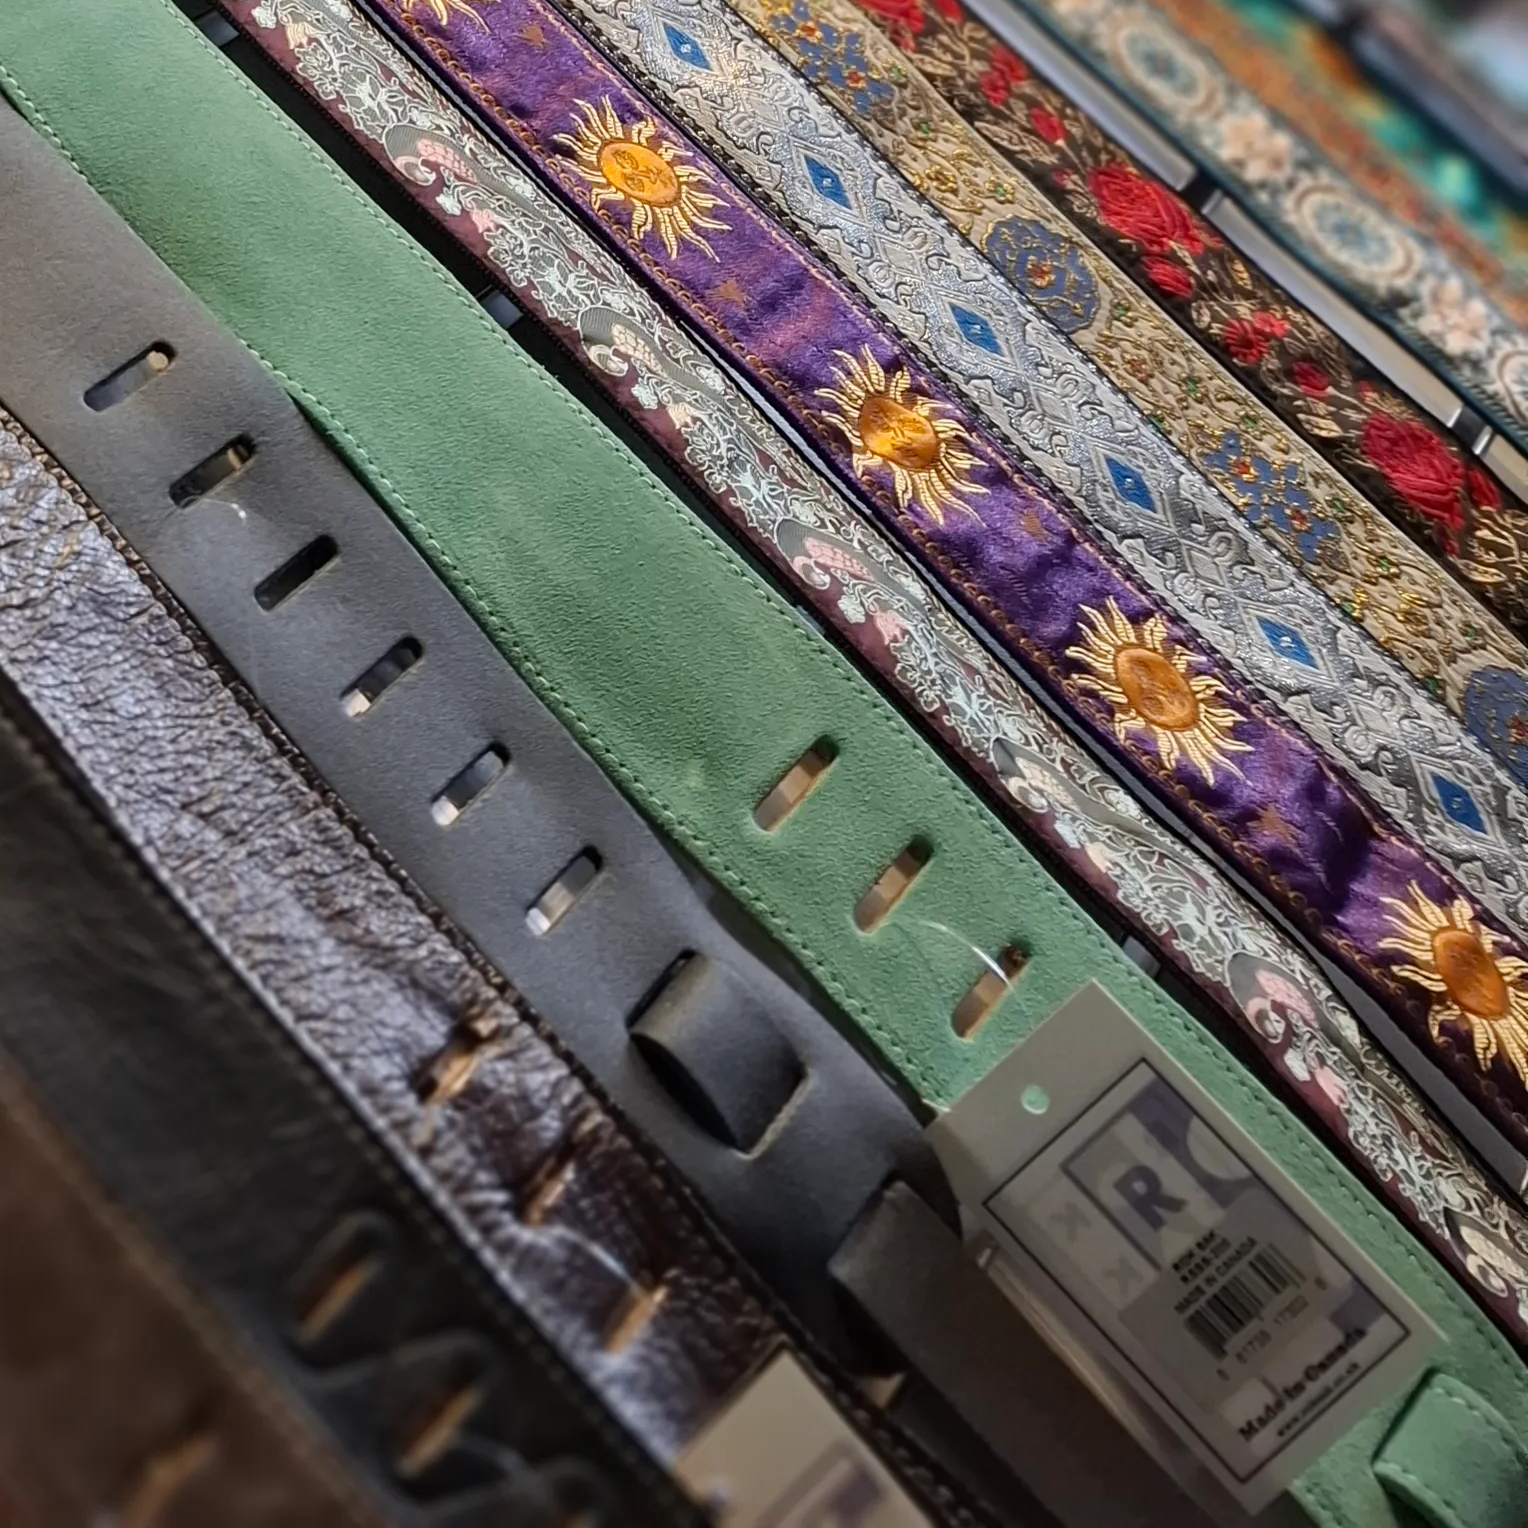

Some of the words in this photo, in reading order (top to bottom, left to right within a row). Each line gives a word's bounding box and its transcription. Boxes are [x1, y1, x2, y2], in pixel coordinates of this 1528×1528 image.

[1112, 1161, 1189, 1235] R
[1172, 1283, 1206, 1316] MADE
[1202, 1271, 1219, 1289] IN
[1212, 1233, 1259, 1278] CANADA
[1236, 1394, 1287, 1442] Made
[1300, 1321, 1368, 1384] Canada
